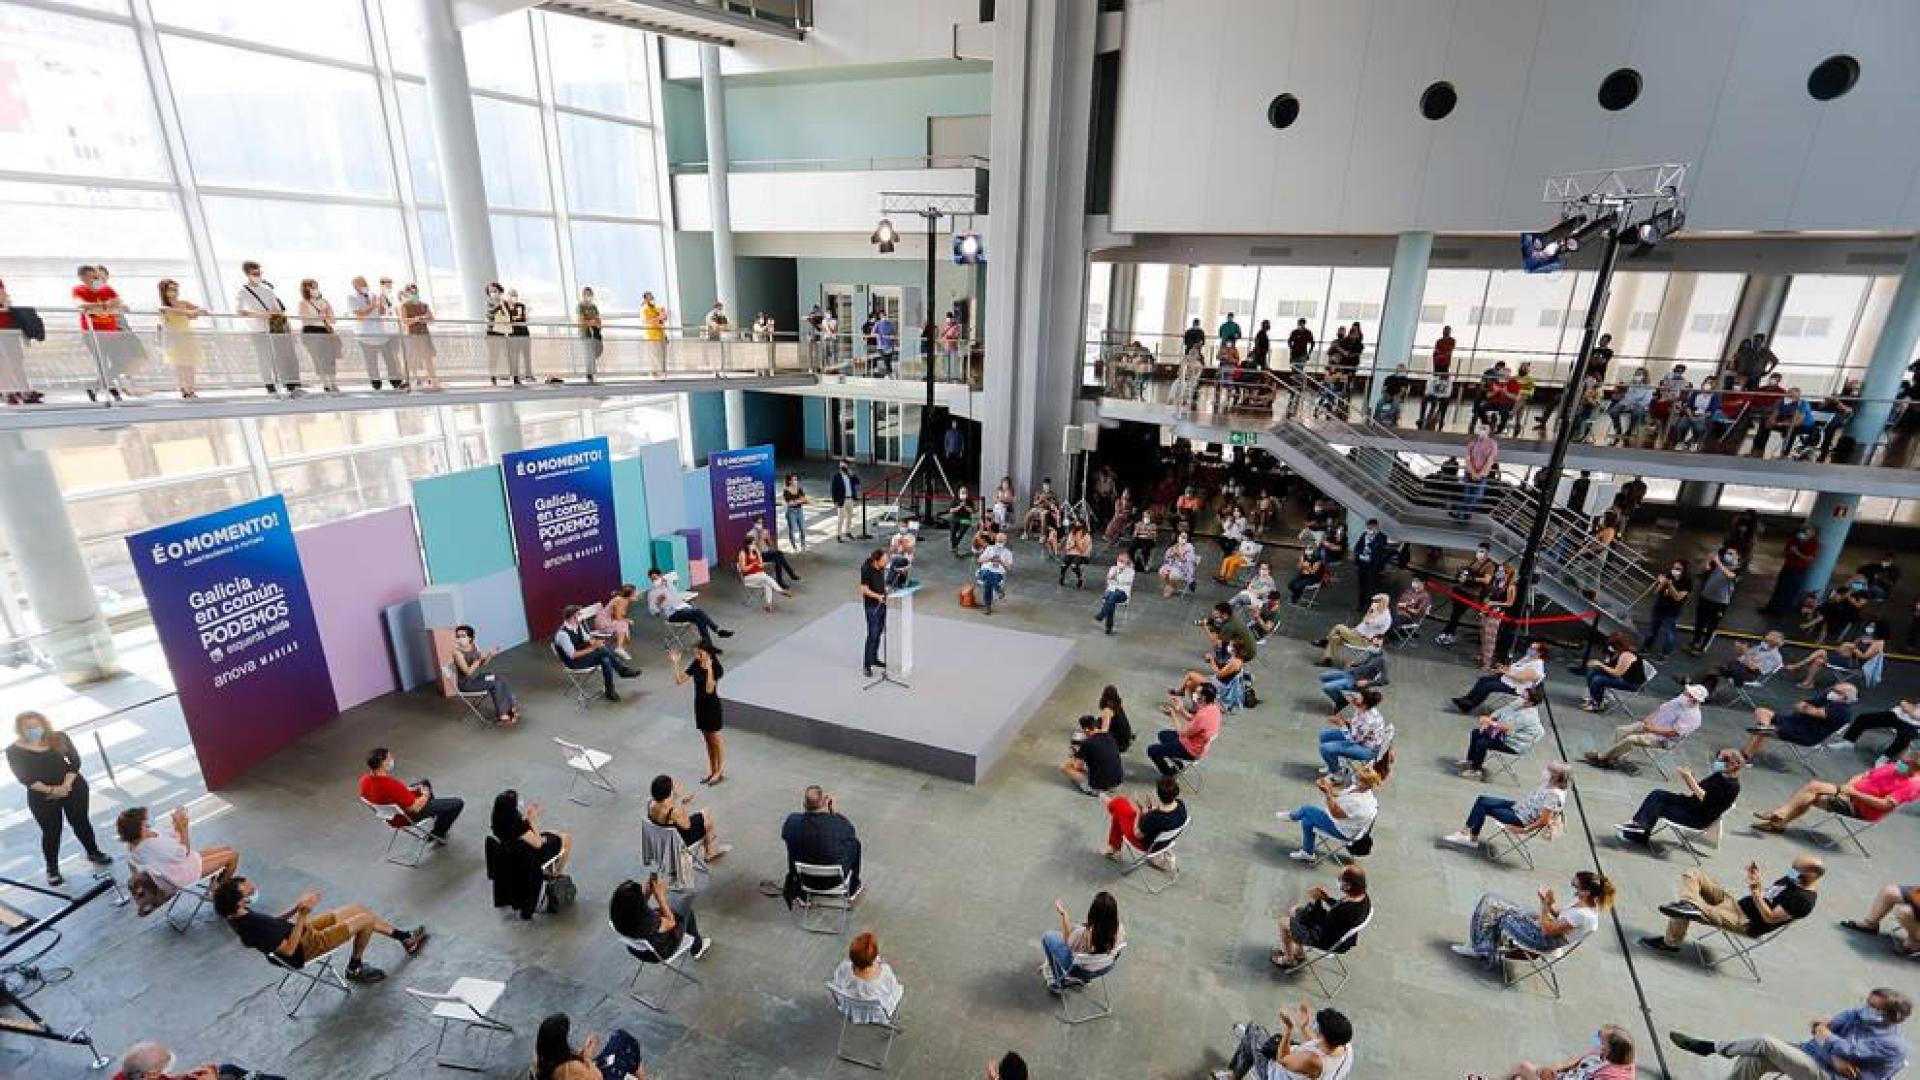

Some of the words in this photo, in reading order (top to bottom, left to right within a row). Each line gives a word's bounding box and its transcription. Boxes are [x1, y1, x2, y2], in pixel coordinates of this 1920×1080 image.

[527, 462, 537, 474] O
[538, 449, 602, 473] MOMENTO!
[535, 491, 577, 511] Galicia
[536, 511, 554, 522] en
[539, 514, 600, 540] PODEMOS
[152, 542, 168, 565] É
[168, 542, 184, 559] O
[183, 512, 280, 554] MOMENTO!
[190, 577, 253, 609] Galicia
[195, 606, 220, 624] en
[222, 583, 284, 614] común.
[201, 601, 289, 650] PODEMOS
[214, 660, 257, 688] anova
